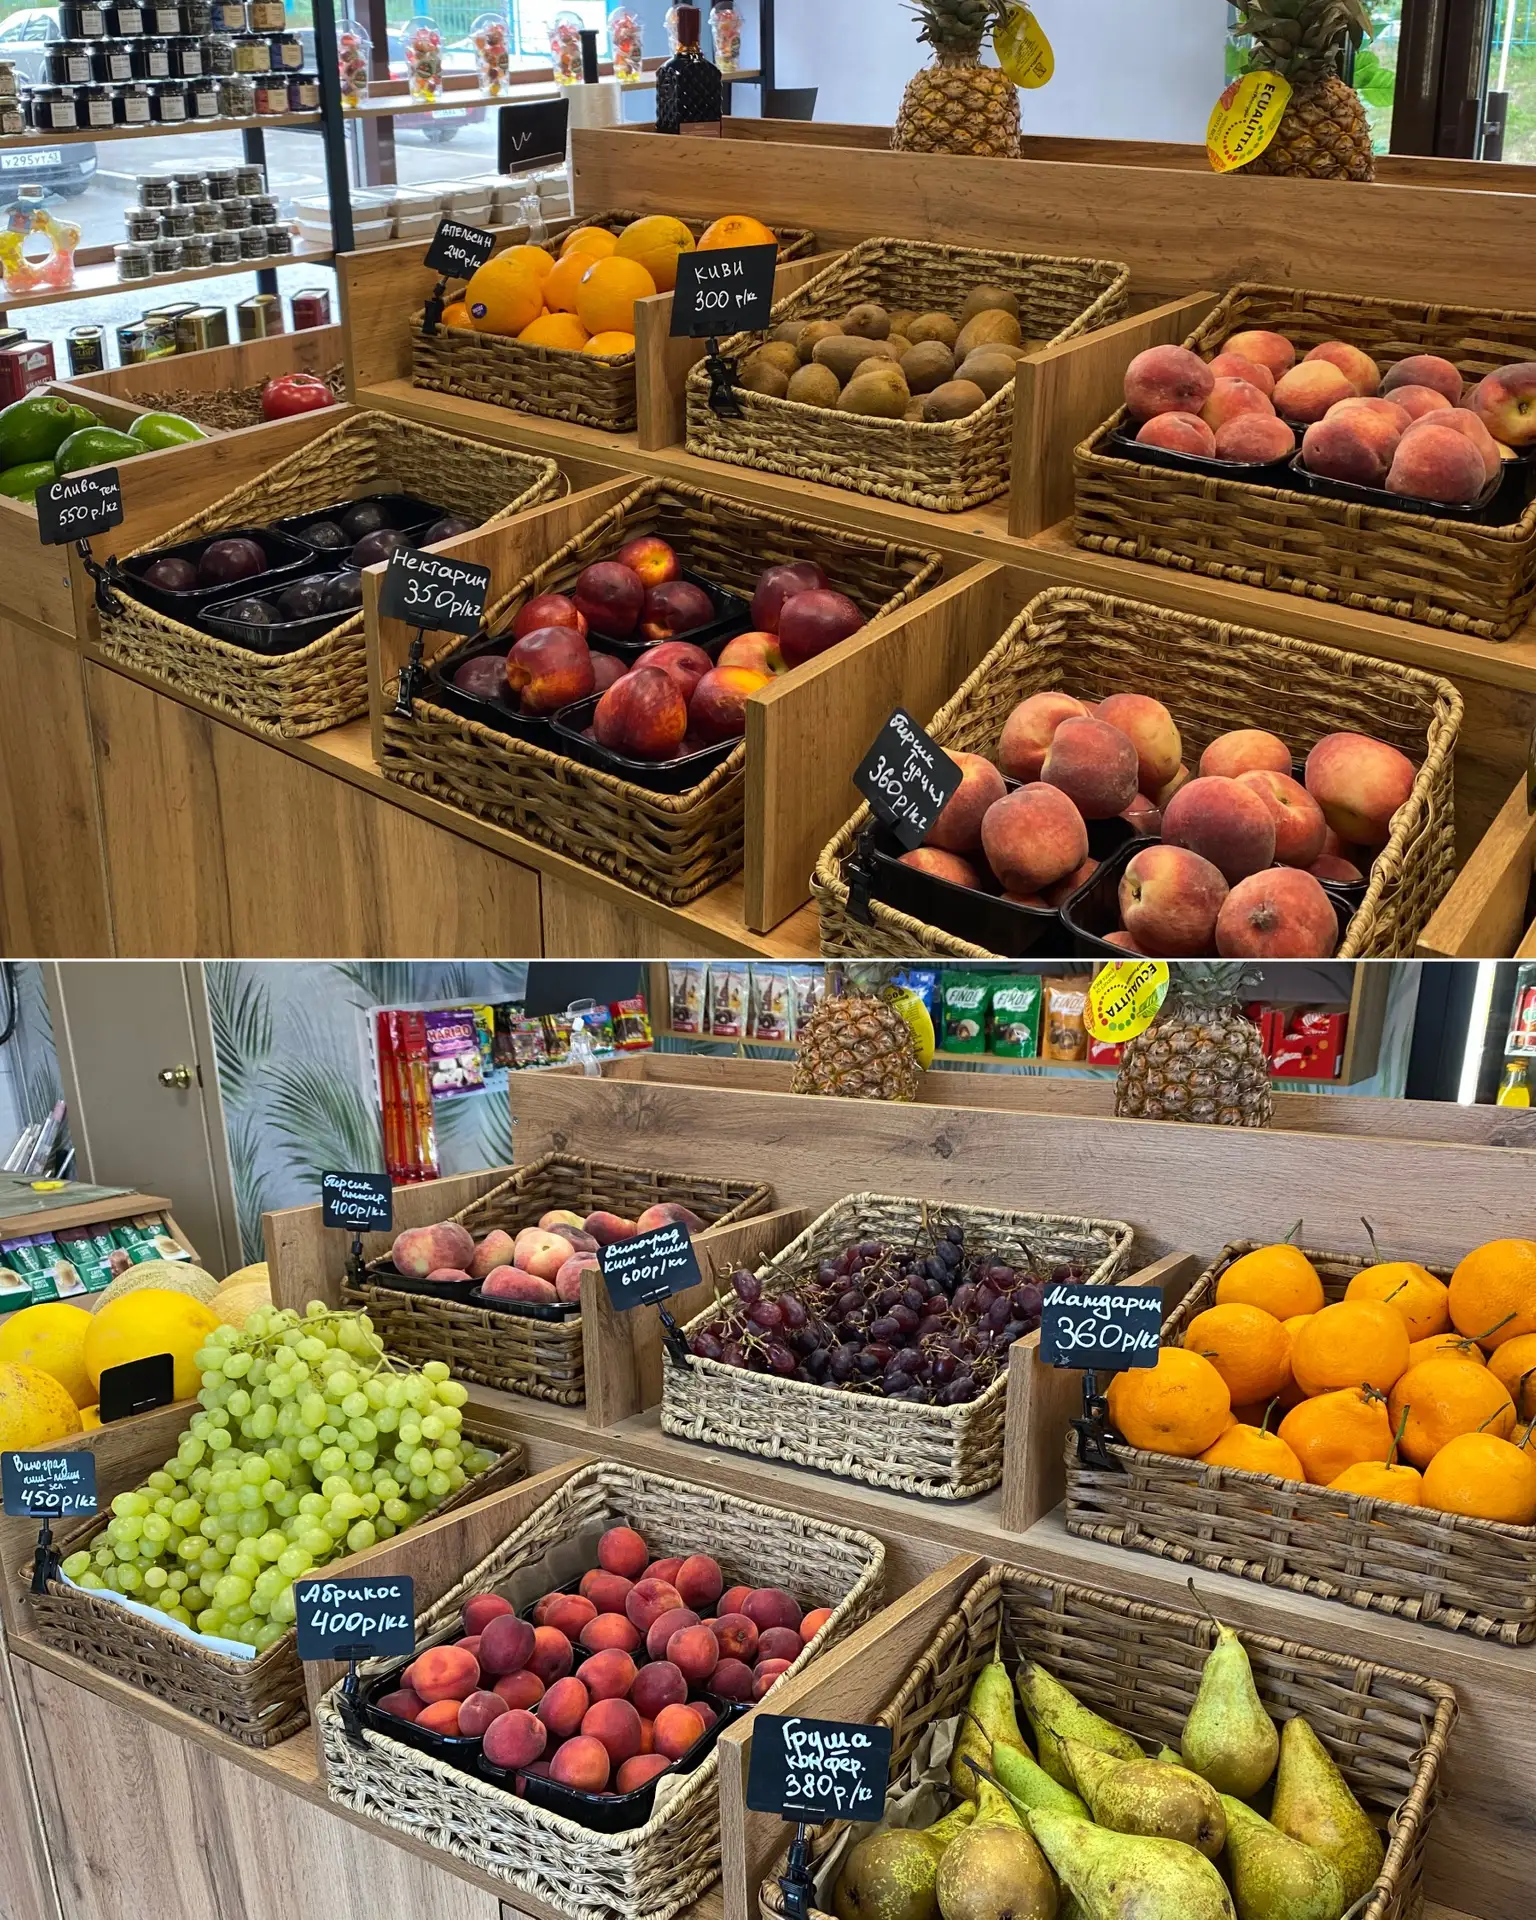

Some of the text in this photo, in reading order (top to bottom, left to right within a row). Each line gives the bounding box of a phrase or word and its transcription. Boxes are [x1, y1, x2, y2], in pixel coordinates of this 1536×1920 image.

[1233, 83, 1276, 152] ECUALITTA
[441, 223, 492, 248] АПЕЛЬСИН
[694, 260, 744, 284] КИВИ
[694, 290, 730, 312] 300
[50, 479, 100, 500] Слива
[392, 549, 487, 590] Нектарин
[889, 713, 935, 770] Персик
[1106, 963, 1157, 1017] ECUALITTA
[427, 1023, 472, 1042] HARIBO
[324, 1174, 373, 1191] Персик
[605, 1228, 680, 1259] Виноград
[1043, 1285, 1162, 1321] Мандарин
[12, 1453, 68, 1476] Виноград
[300, 1583, 401, 1608] Абрикос
[782, 1718, 873, 1761] Груша
